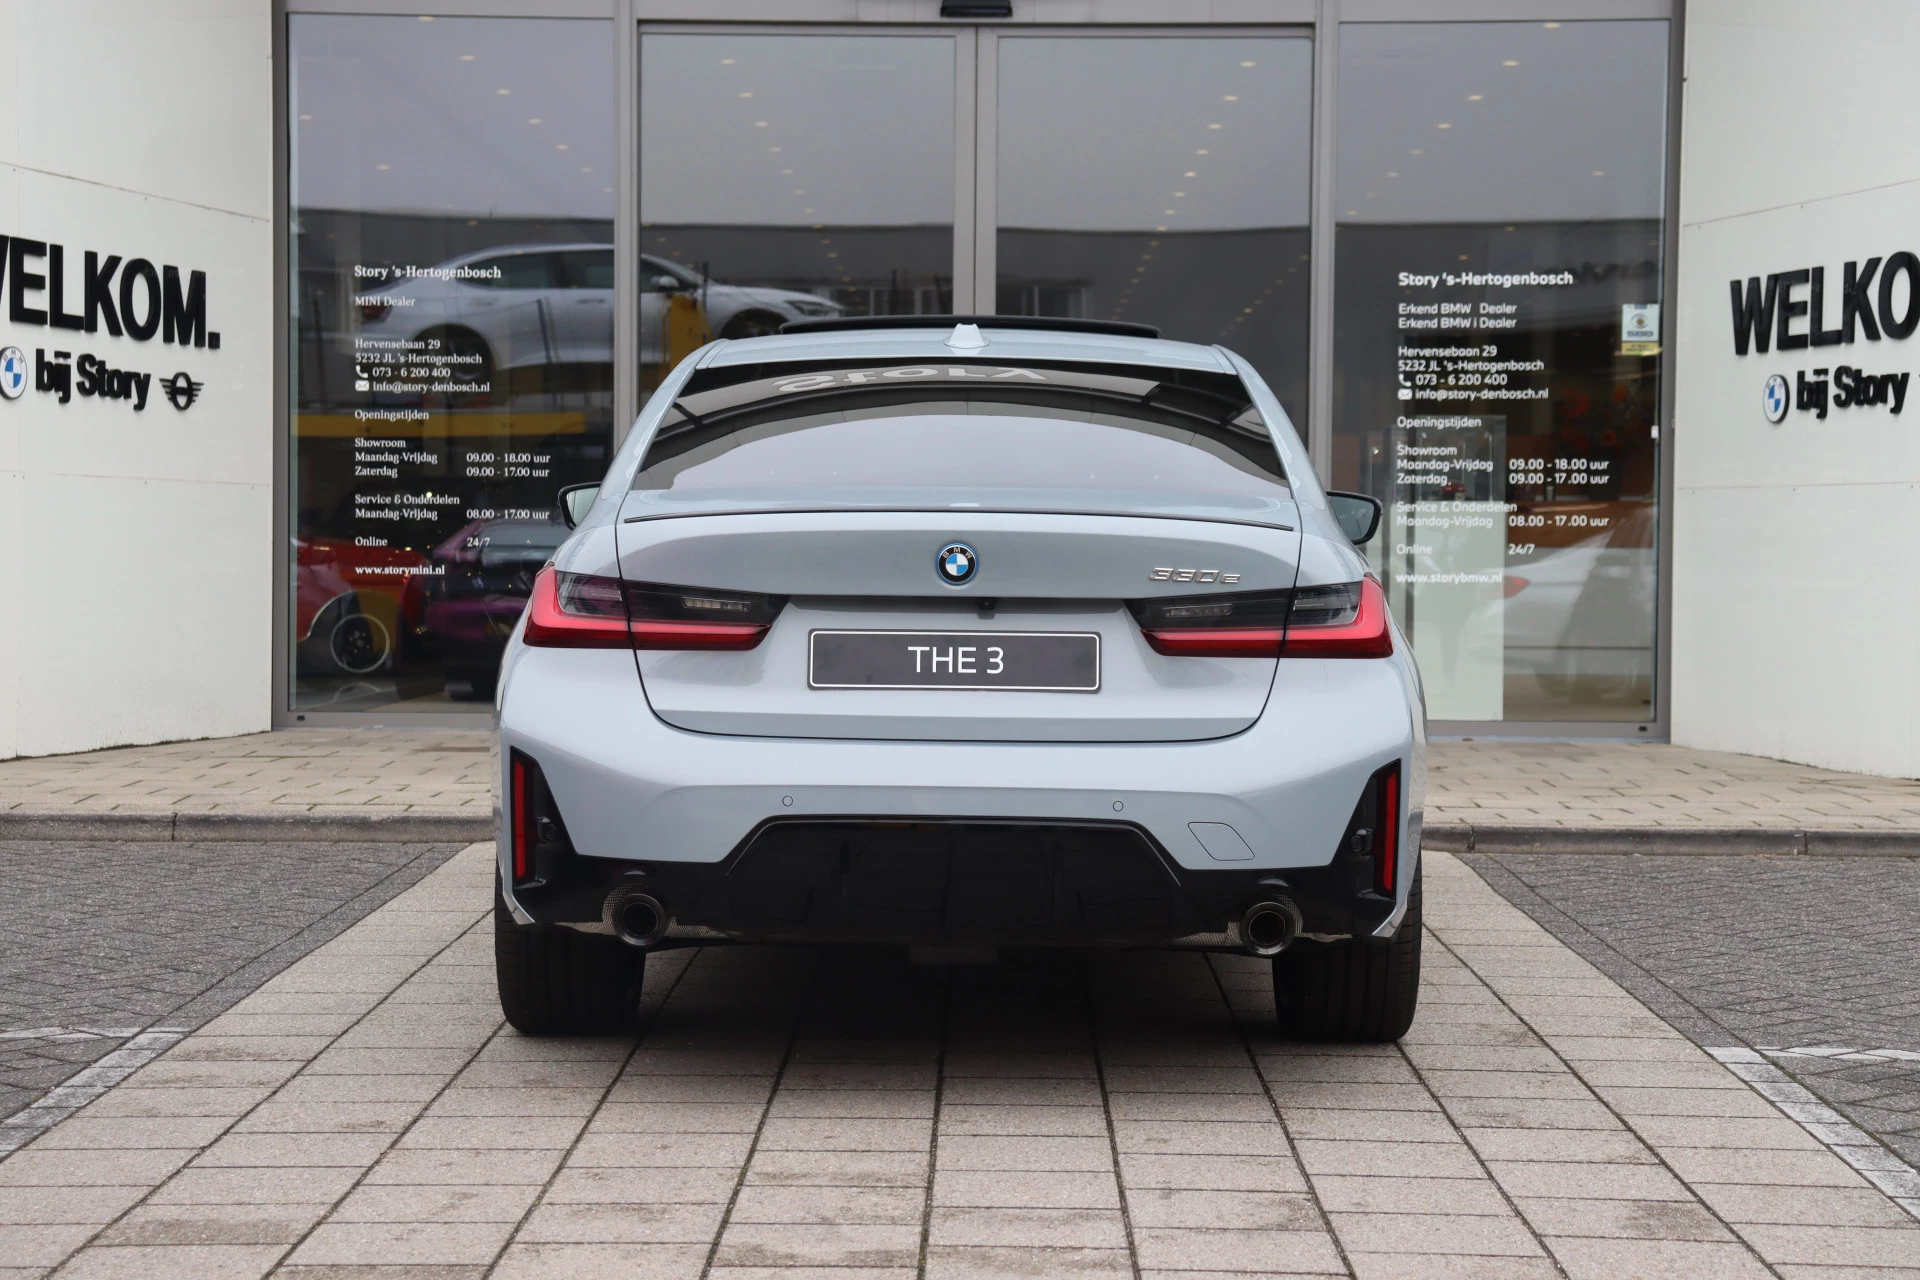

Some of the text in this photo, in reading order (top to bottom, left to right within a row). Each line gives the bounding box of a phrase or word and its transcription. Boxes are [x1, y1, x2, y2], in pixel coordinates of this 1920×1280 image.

[354, 265, 502, 281] Story 's-Hertogenbosch
[1398, 272, 1439, 288] Story
[1442, 272, 1573, 288] 's-Hertogenbosch
[0, 234, 220, 350] ELKOM.
[355, 296, 416, 307] MINI Dealer
[1730, 251, 1920, 355] WELKO
[1398, 303, 1517, 314] Erkend BMW Dealer
[1398, 317, 1517, 328] Erkend BMW i Dealer
[355, 338, 441, 350] Hervensebaan 29
[1398, 345, 1498, 357] Hervensebaan 29
[355, 353, 483, 365] 5232 JL 's-Hertogenbosch
[372, 367, 391, 378] 073
[400, 368, 407, 378] 6
[410, 368, 429, 378] 200
[431, 368, 451, 378] 400
[1398, 360, 1544, 374] 5232 JL 's-Hertogenbosch
[76, 353, 151, 411] Story
[1415, 374, 1437, 385] 073
[1447, 374, 1455, 385] 6
[1458, 374, 1481, 385] 200
[1484, 374, 1507, 385] 400
[373, 381, 490, 394] info@story-denbosch.nl
[1833, 365, 1910, 414] Story
[1415, 388, 1549, 401] info@story-denbosch.nl
[355, 410, 429, 421] Openingstijden
[1397, 416, 1481, 428] Openingstijden
[355, 438, 406, 448] Showroom
[1397, 445, 1457, 456] Showroom
[355, 452, 438, 464] Maandag-Vrijdag
[466, 453, 494, 463] 09.00
[504, 453, 531, 463] 18.00
[533, 455, 550, 463] uur
[1397, 459, 1493, 472] Maandag-Vrijdag
[1509, 459, 1544, 470] 09.00
[1554, 459, 1587, 470] 18.00
[1590, 461, 1609, 470] uur
[355, 466, 398, 478] Zaterdag
[466, 467, 494, 477] 09.00
[504, 467, 530, 477] 17.00
[532, 469, 550, 477] uur
[1397, 473, 1447, 486] Zaterdag
[1509, 473, 1544, 484] 09.00
[1554, 473, 1587, 484] 17.00
[1590, 475, 1609, 484] uur
[355, 494, 460, 505] Service & Onderdelen
[1396, 501, 1518, 512] Service & Onderdelen
[355, 509, 438, 521] Maandag-Vrijdag
[466, 509, 494, 519] 08.00
[504, 509, 530, 519] 17.00
[532, 511, 550, 519] uur
[1396, 515, 1493, 529] Maandag-Vrijdag
[1509, 515, 1544, 526] 08.00
[1554, 515, 1587, 526] 17.00
[1590, 517, 1609, 526] uur
[355, 537, 491, 548] Online 24/7
[942, 547, 973, 559] BMW
[1396, 544, 1535, 556] Online 24/7
[355, 565, 445, 576] www.storymini.nl
[1148, 567, 1241, 584] 330e
[1395, 572, 1503, 586] www.storybmw.nl
[908, 646, 1005, 675] THE 3
